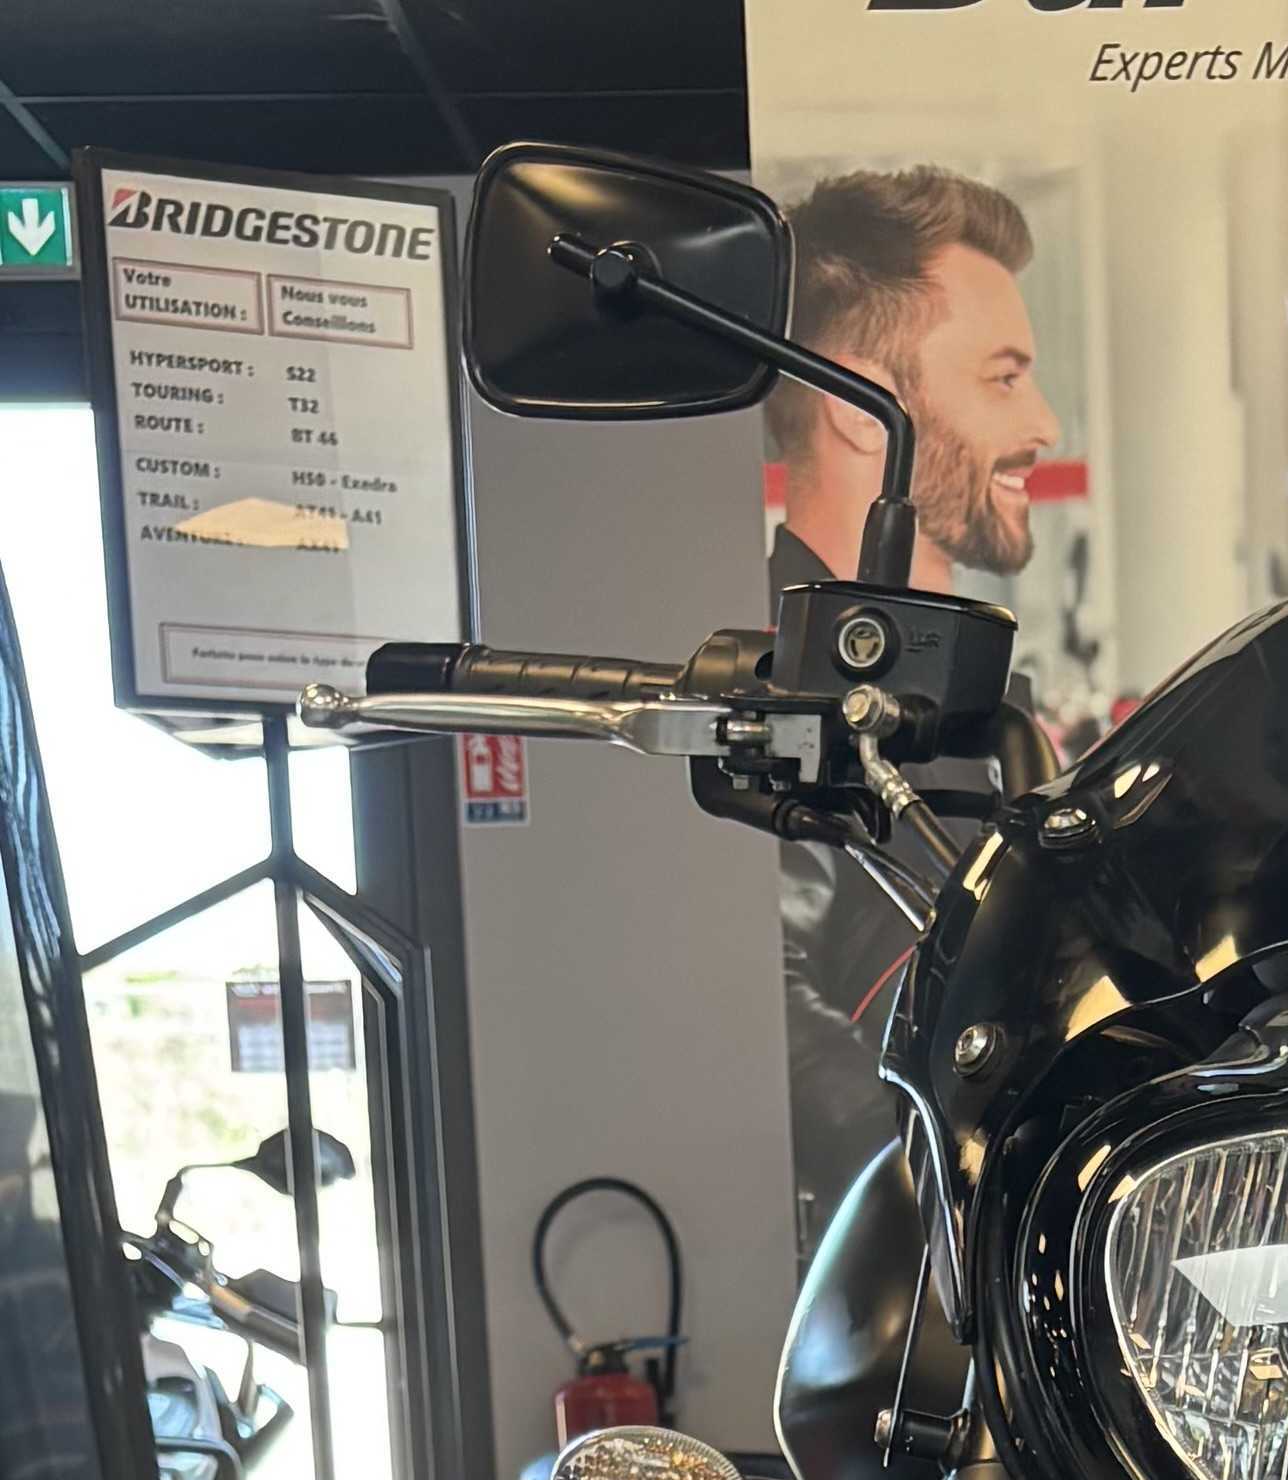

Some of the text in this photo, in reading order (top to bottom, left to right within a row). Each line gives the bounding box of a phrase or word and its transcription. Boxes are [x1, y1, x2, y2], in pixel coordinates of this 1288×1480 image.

[1088, 42, 1243, 93] Experts
[107, 188, 435, 260] BRIDGESTONE
[122, 268, 171, 287] Votre
[124, 294, 238, 320] UTILISATION
[281, 285, 368, 308] Nous vous
[129, 350, 242, 376] HYPERSPORT
[286, 366, 317, 383] S22
[130, 382, 214, 403] TOURING
[288, 397, 319, 414] T32
[134, 415, 193, 433] ROUTE
[135, 457, 210, 478] CUSTOM
[138, 491, 190, 510] TRAIL
